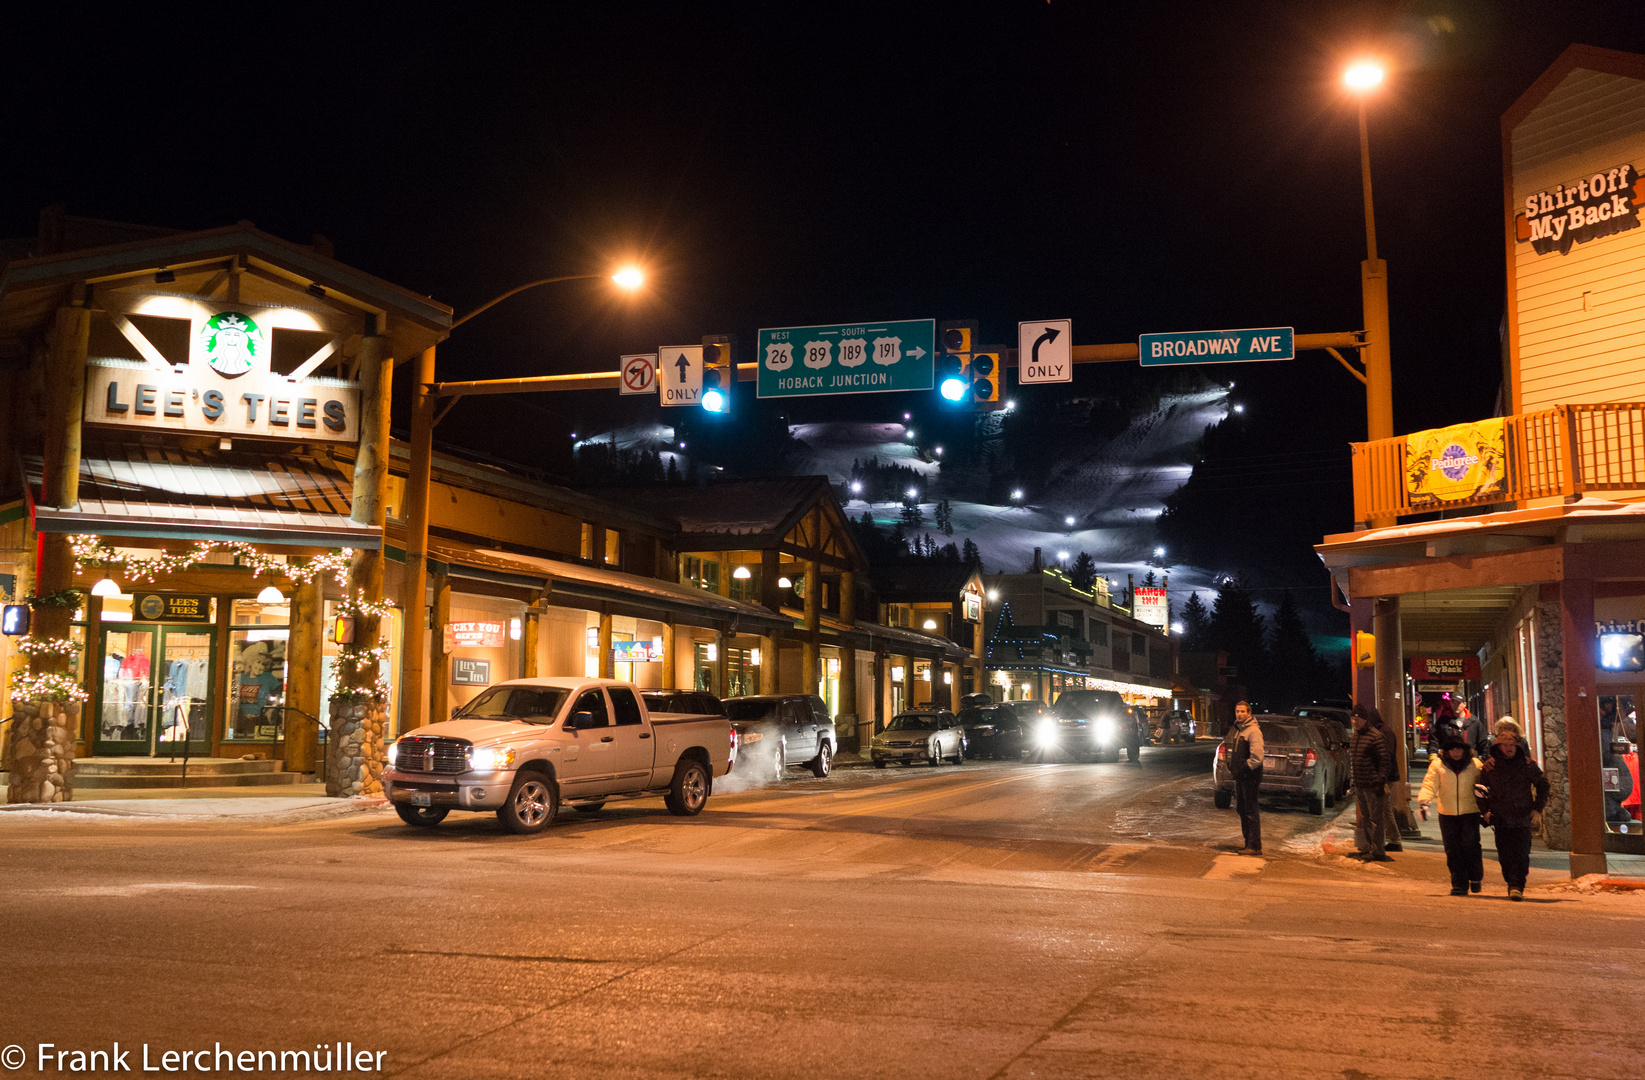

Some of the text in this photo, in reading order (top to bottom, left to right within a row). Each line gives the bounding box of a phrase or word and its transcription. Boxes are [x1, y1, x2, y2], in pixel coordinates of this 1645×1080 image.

[1525, 164, 1630, 218] ShirtOff
[1528, 194, 1630, 241] MyBack
[771, 332, 791, 340] WEST
[841, 328, 866, 336] SOUTH
[843, 345, 862, 360] 189
[879, 343, 895, 358] 191
[1151, 336, 1282, 358] BROADWAY AVE
[771, 350, 788, 364] 26
[809, 347, 827, 362] 89
[1027, 364, 1064, 378] ONLY
[778, 373, 887, 389] HOBACK JUNCTION
[666, 388, 699, 401] ONLY
[108, 381, 345, 430] LEE'S TEES
[1431, 455, 1479, 471] Pedigree
[1135, 587, 1166, 597] RANCH
[169, 598, 199, 606] LEE'S
[1142, 597, 1159, 606] INN
[169, 606, 198, 615] TEES
[452, 622, 500, 633] CKY YOU
[1595, 620, 1645, 638] hirtO
[1428, 666, 1463, 674] MyBack
